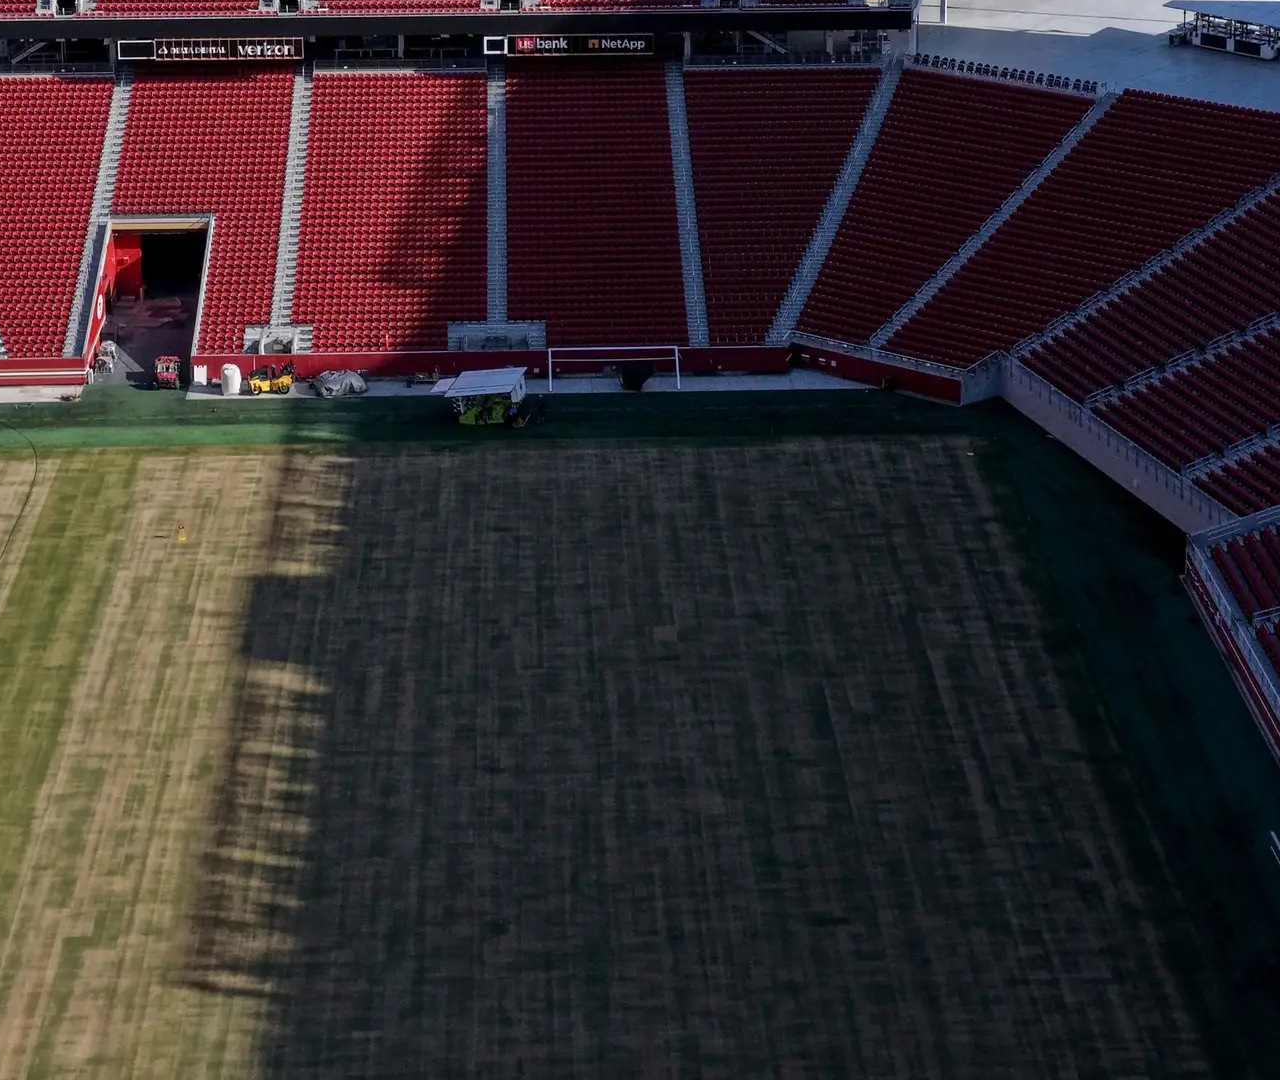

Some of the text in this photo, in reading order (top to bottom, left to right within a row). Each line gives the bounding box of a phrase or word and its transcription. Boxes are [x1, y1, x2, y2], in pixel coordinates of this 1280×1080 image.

[537, 38, 568, 49] bank
[602, 39, 645, 50] NetApp
[238, 43, 295, 56] verizon
